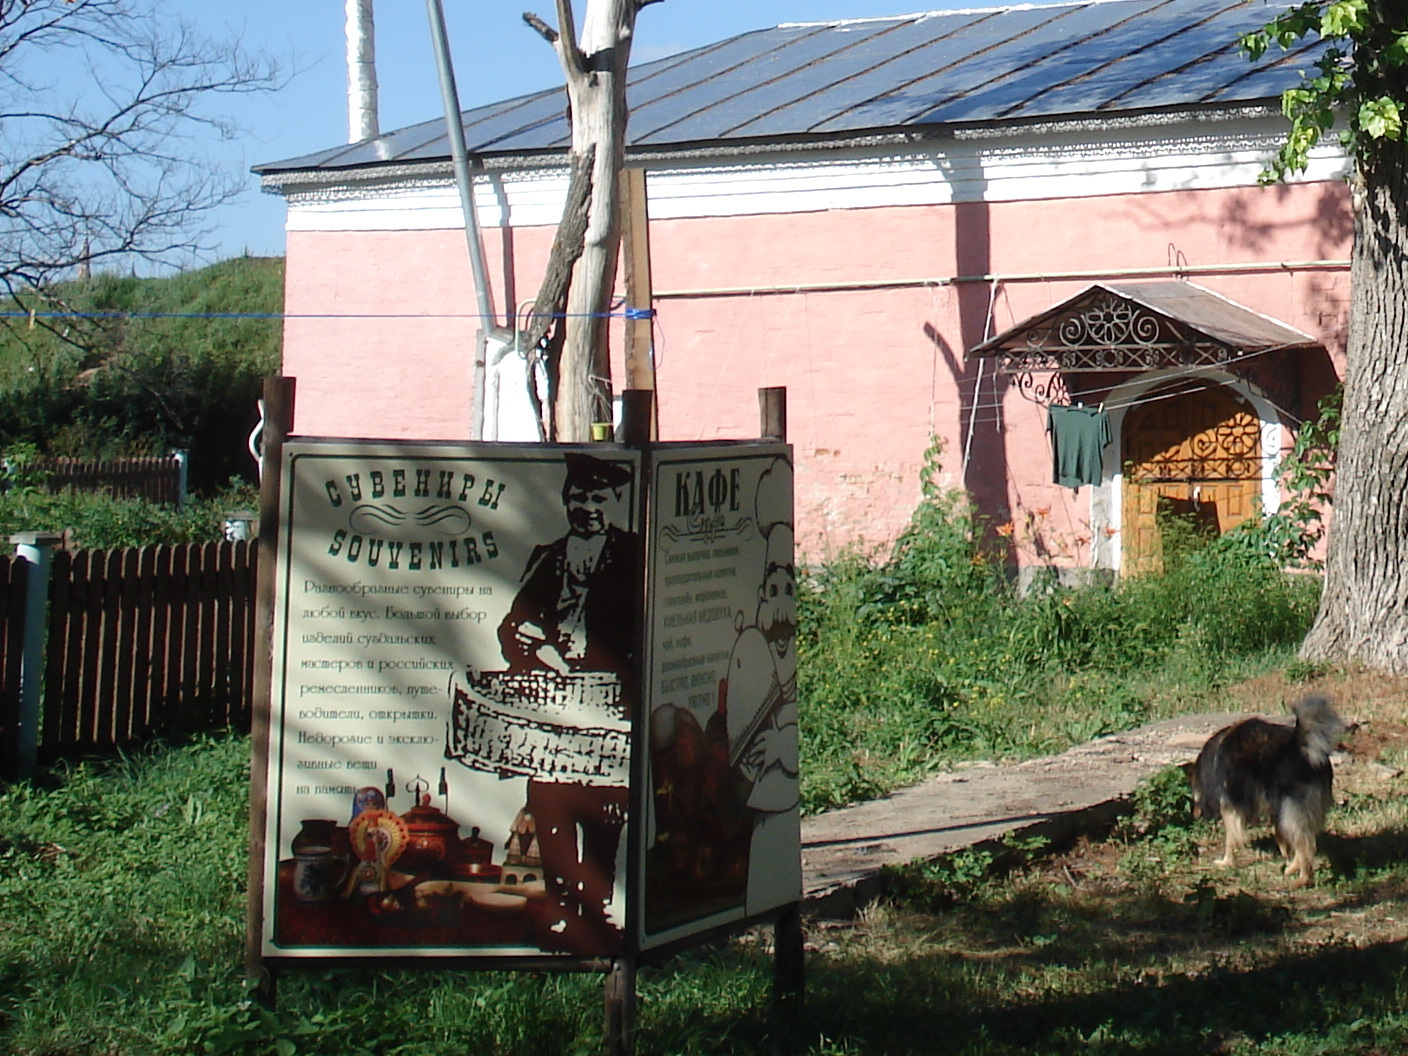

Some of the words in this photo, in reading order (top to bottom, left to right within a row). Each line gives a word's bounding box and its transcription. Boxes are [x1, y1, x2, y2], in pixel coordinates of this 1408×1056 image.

[324, 468, 506, 510] СУВЕНИРЫ
[674, 468, 740, 516] КАФЕ
[328, 528, 500, 570] SOUVENIRS
[304, 580, 409, 597] Разнообразные
[413, 585, 474, 598] сувениры
[478, 586, 492, 595] на
[302, 606, 344, 620] любой
[349, 610, 380, 623] вкус.
[385, 606, 440, 620] Большой
[444, 608, 487, 624] выбор
[302, 632, 353, 644] изделий
[357, 632, 436, 648] суздальских
[301, 660, 362, 672] мастеров
[366, 660, 374, 670] и
[378, 659, 454, 672] российских
[300, 684, 402, 698] ремесленников,
[407, 685, 442, 698] путе-
[298, 707, 364, 720] водители,
[298, 730, 372, 747] Недорогие
[376, 734, 384, 744] и
[388, 735, 439, 745] эксклю-
[296, 759, 342, 770] зивные
[346, 760, 378, 771] вещи
[296, 786, 310, 795] на
